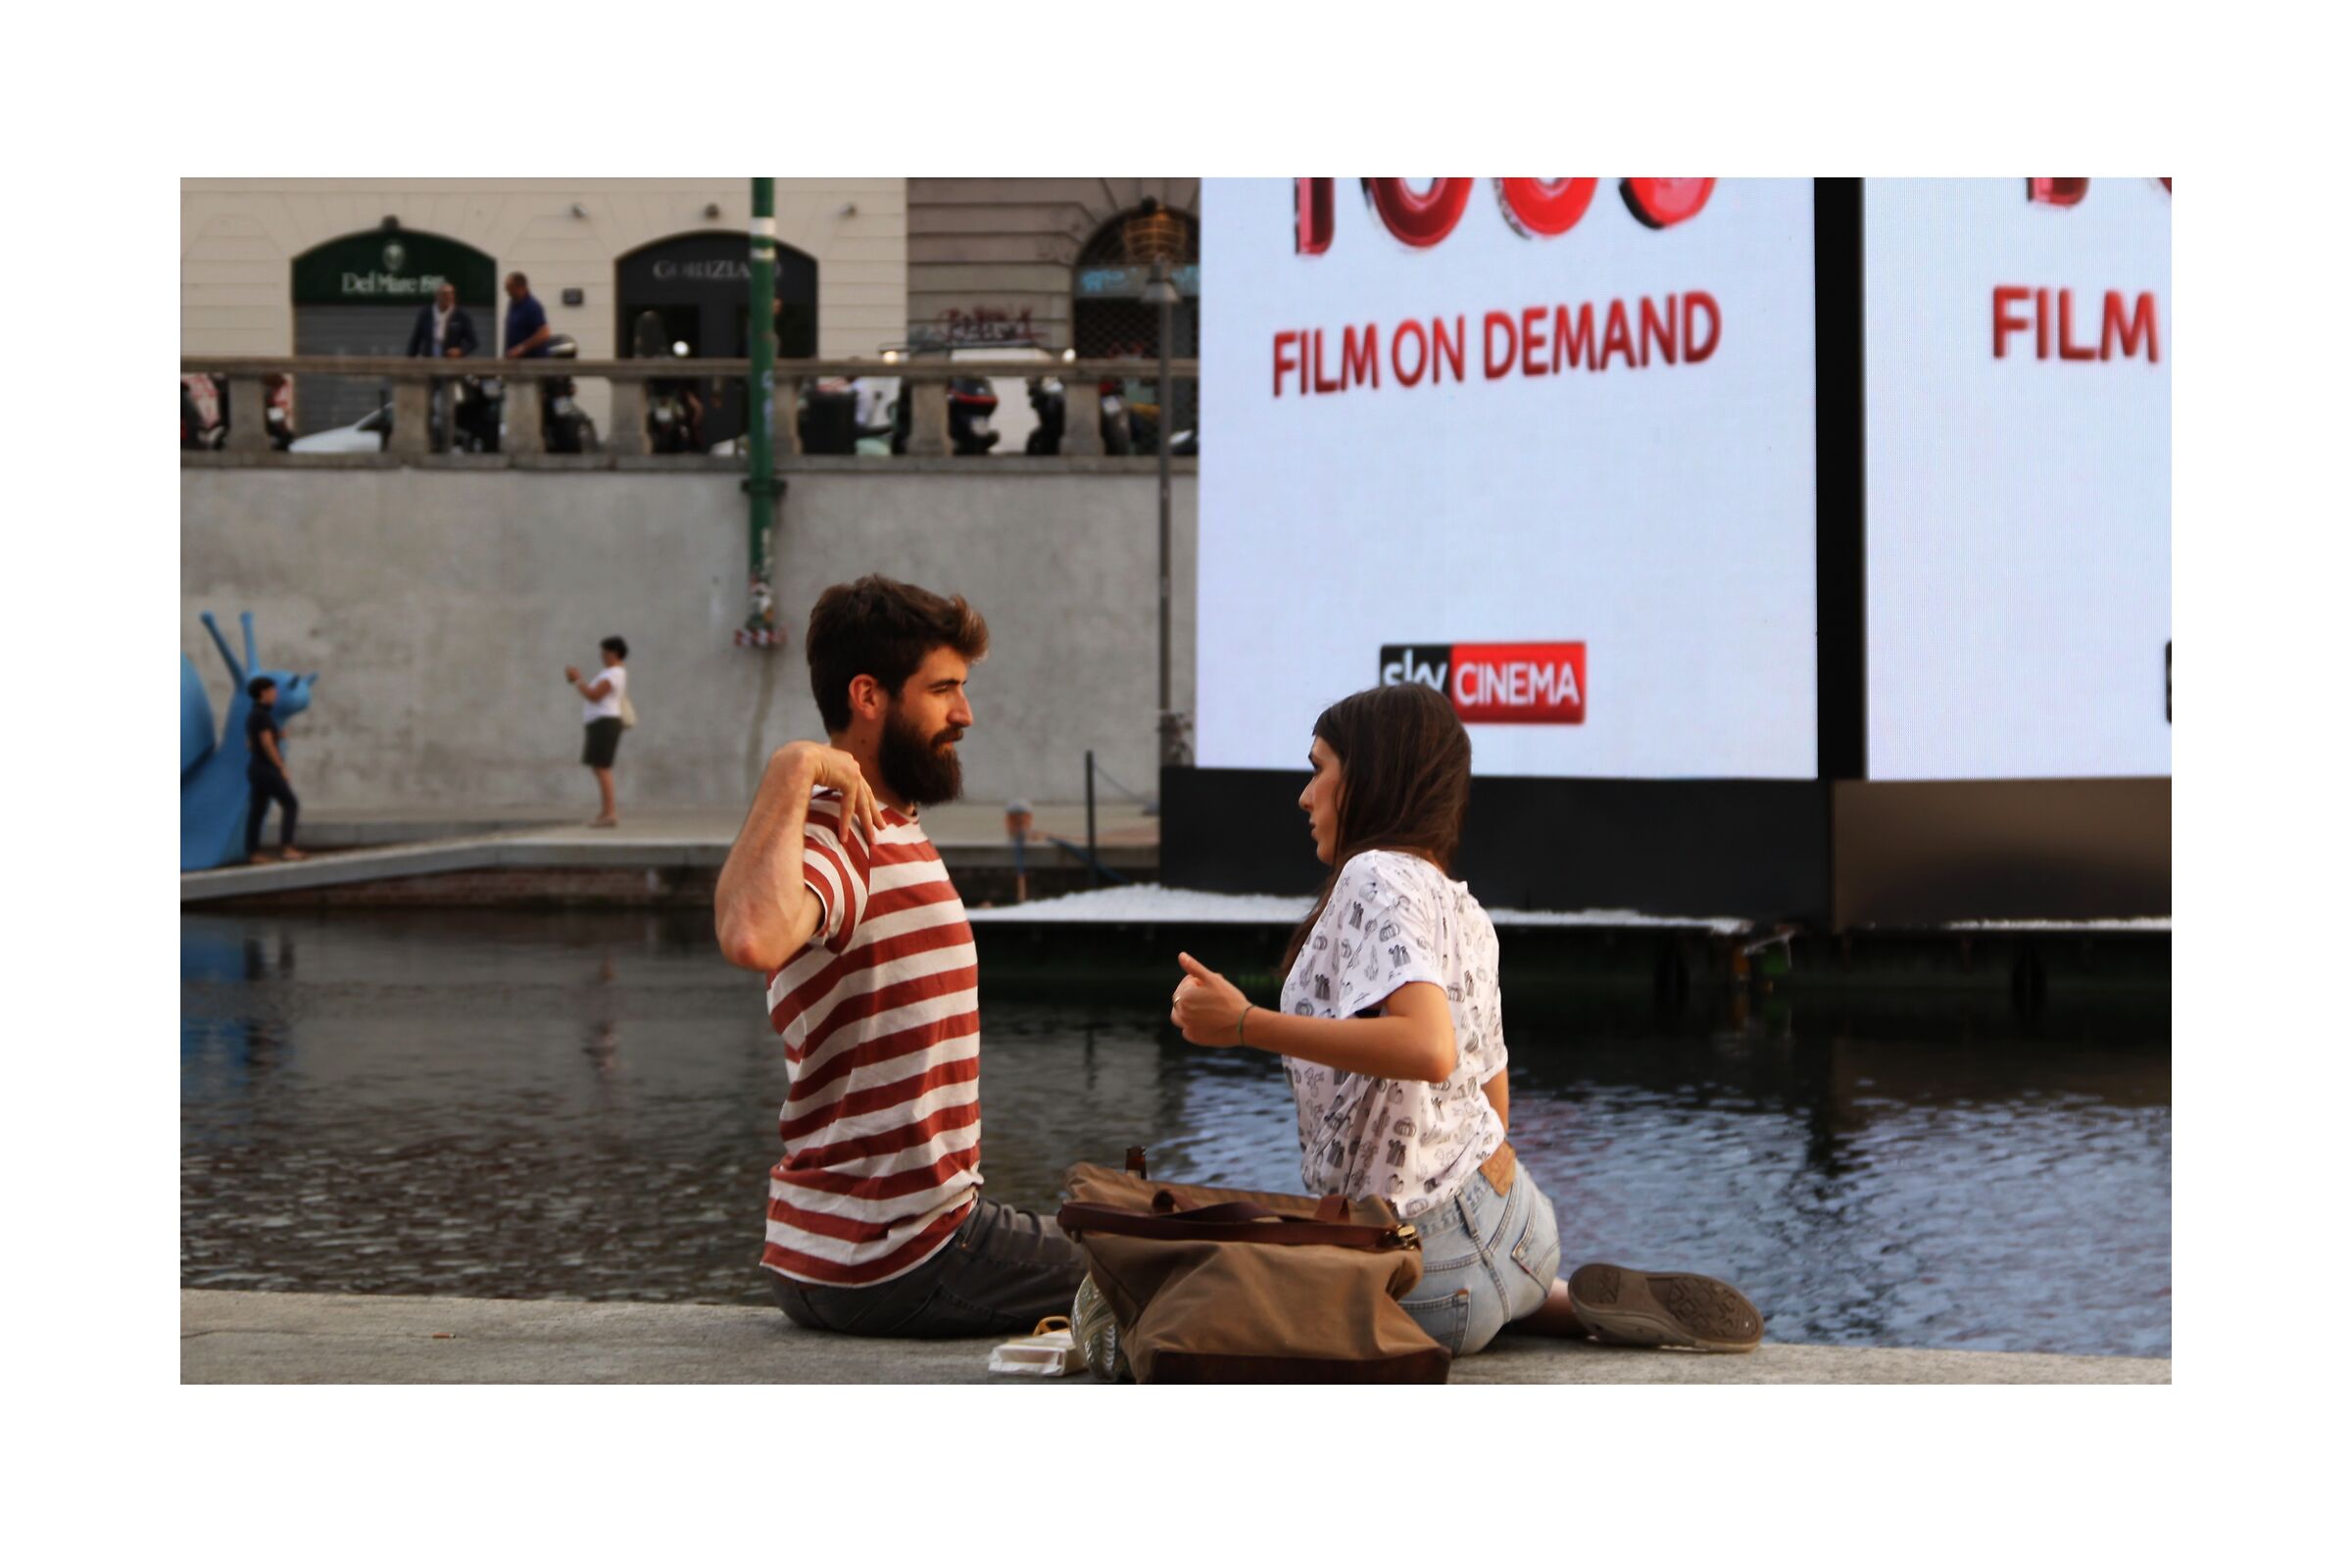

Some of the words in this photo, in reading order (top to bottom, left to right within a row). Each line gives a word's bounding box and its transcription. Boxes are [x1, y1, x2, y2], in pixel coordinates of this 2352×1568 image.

[341, 270, 374, 294] Del
[1273, 322, 1380, 398] FILM
[1391, 314, 1465, 387] ON
[1483, 289, 1722, 380] DEMAND
[1992, 284, 2160, 363] FILM
[1453, 661, 1581, 707] CINEMA
